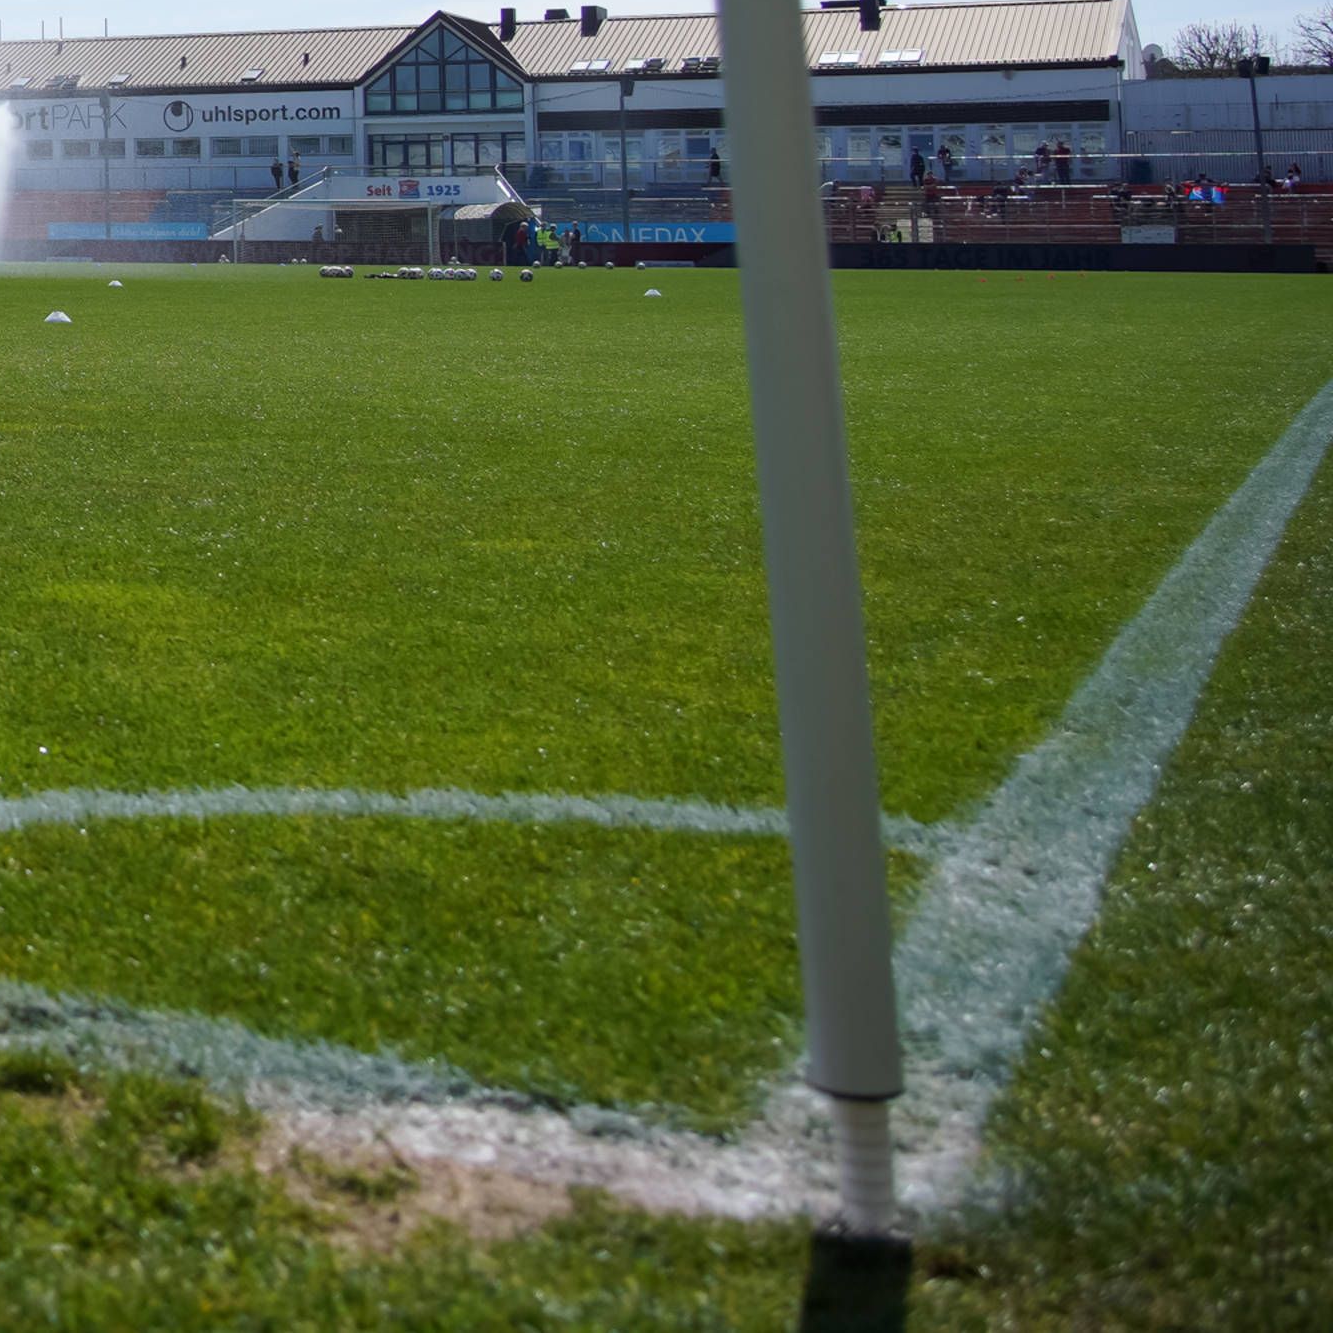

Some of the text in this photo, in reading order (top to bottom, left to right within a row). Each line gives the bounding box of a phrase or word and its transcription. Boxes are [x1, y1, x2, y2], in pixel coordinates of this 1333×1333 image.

[202, 105, 341, 125] uhlsport.com
[367, 185, 461, 197] Seit 1925
